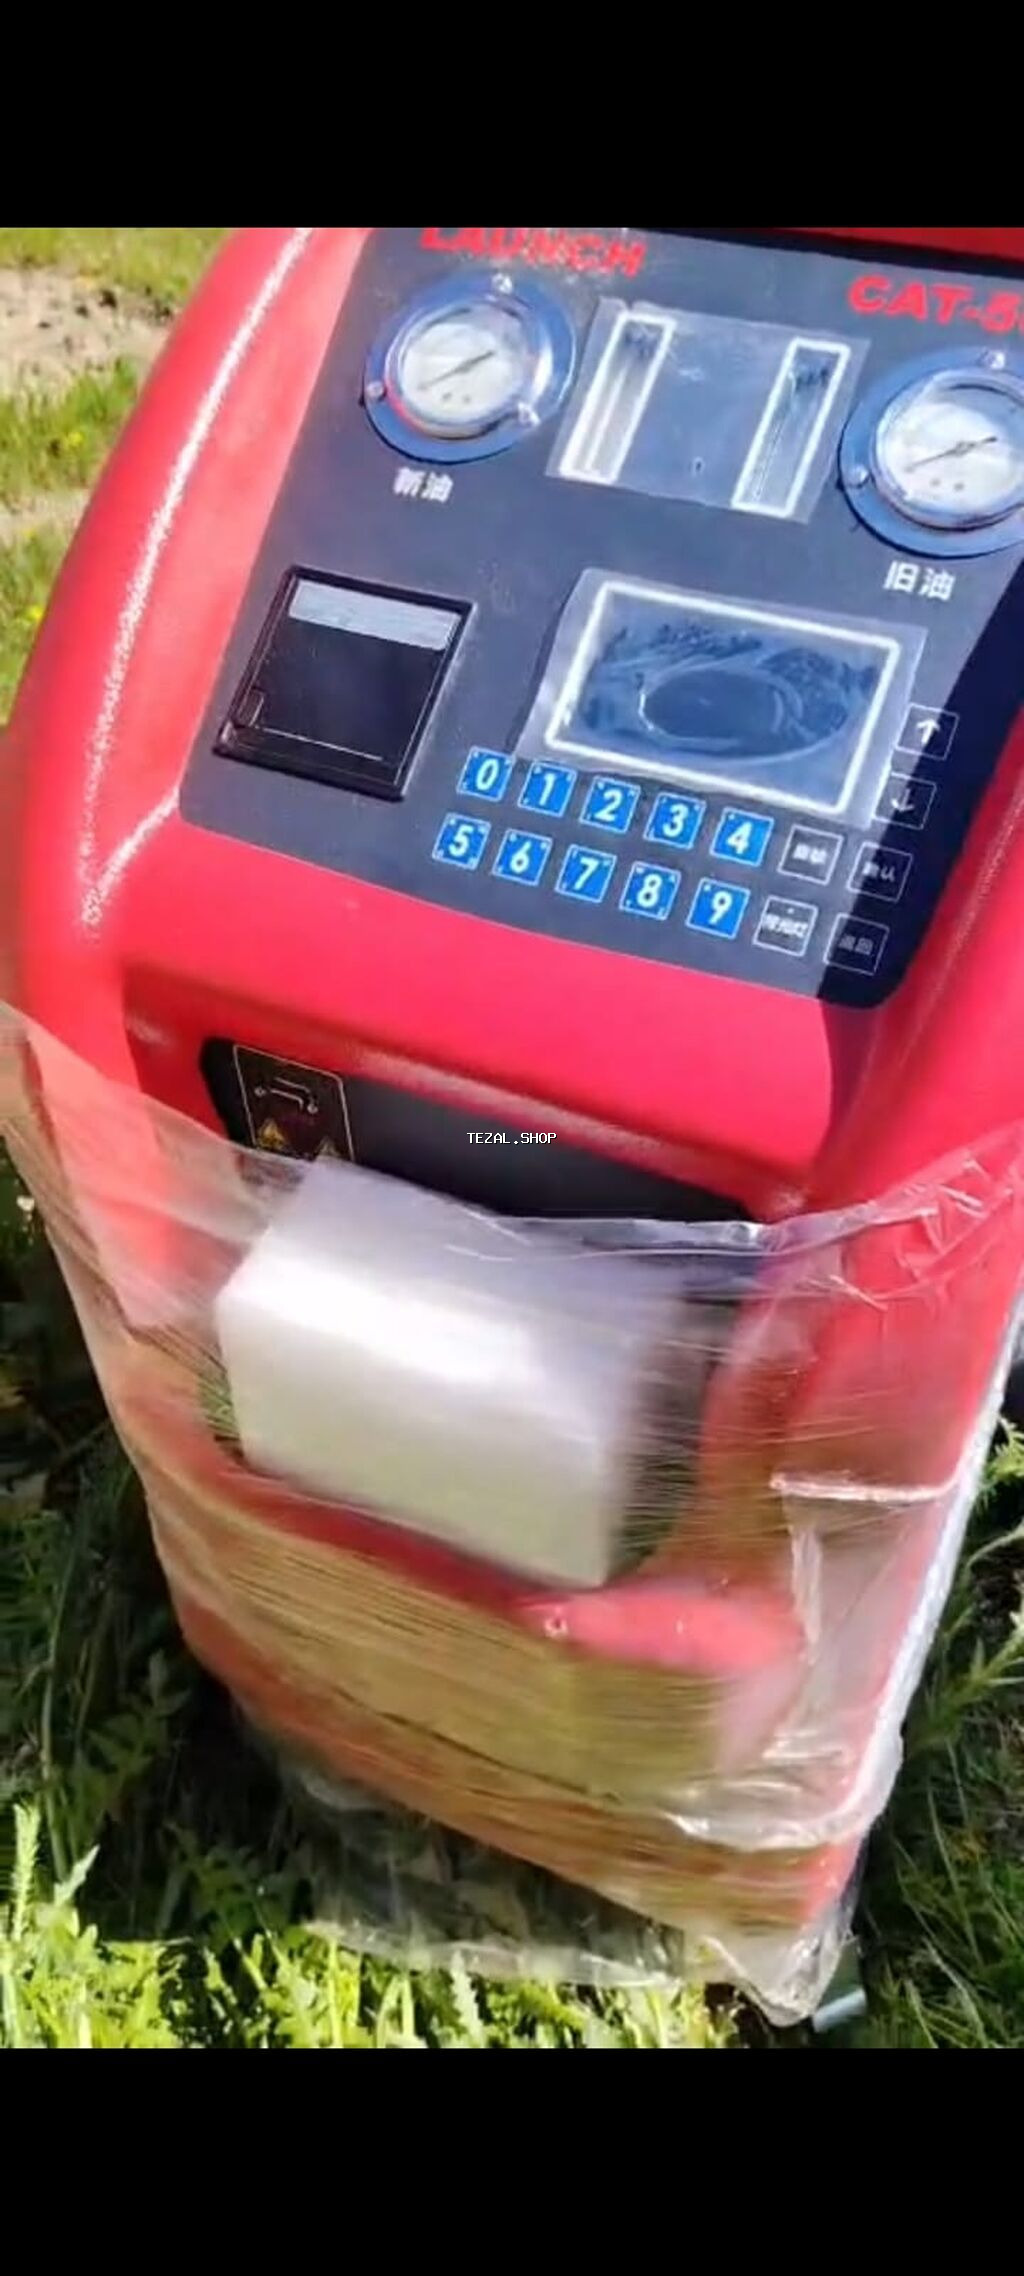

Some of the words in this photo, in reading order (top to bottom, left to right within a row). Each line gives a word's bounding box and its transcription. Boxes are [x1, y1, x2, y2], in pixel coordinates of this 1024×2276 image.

[421, 227, 646, 277] LAUNCH
[847, 273, 1024, 334] CAT-5
[883, 560, 957, 602] 旧油
[476, 758, 499, 790] 0
[540, 773, 556, 805] 1
[594, 789, 622, 822] 2
[663, 803, 689, 837] 3
[726, 822, 752, 854] 4
[449, 824, 474, 857] 5
[510, 841, 531, 873] 6
[574, 857, 599, 890] 7
[637, 874, 663, 907] 8
[709, 891, 732, 924] 9
